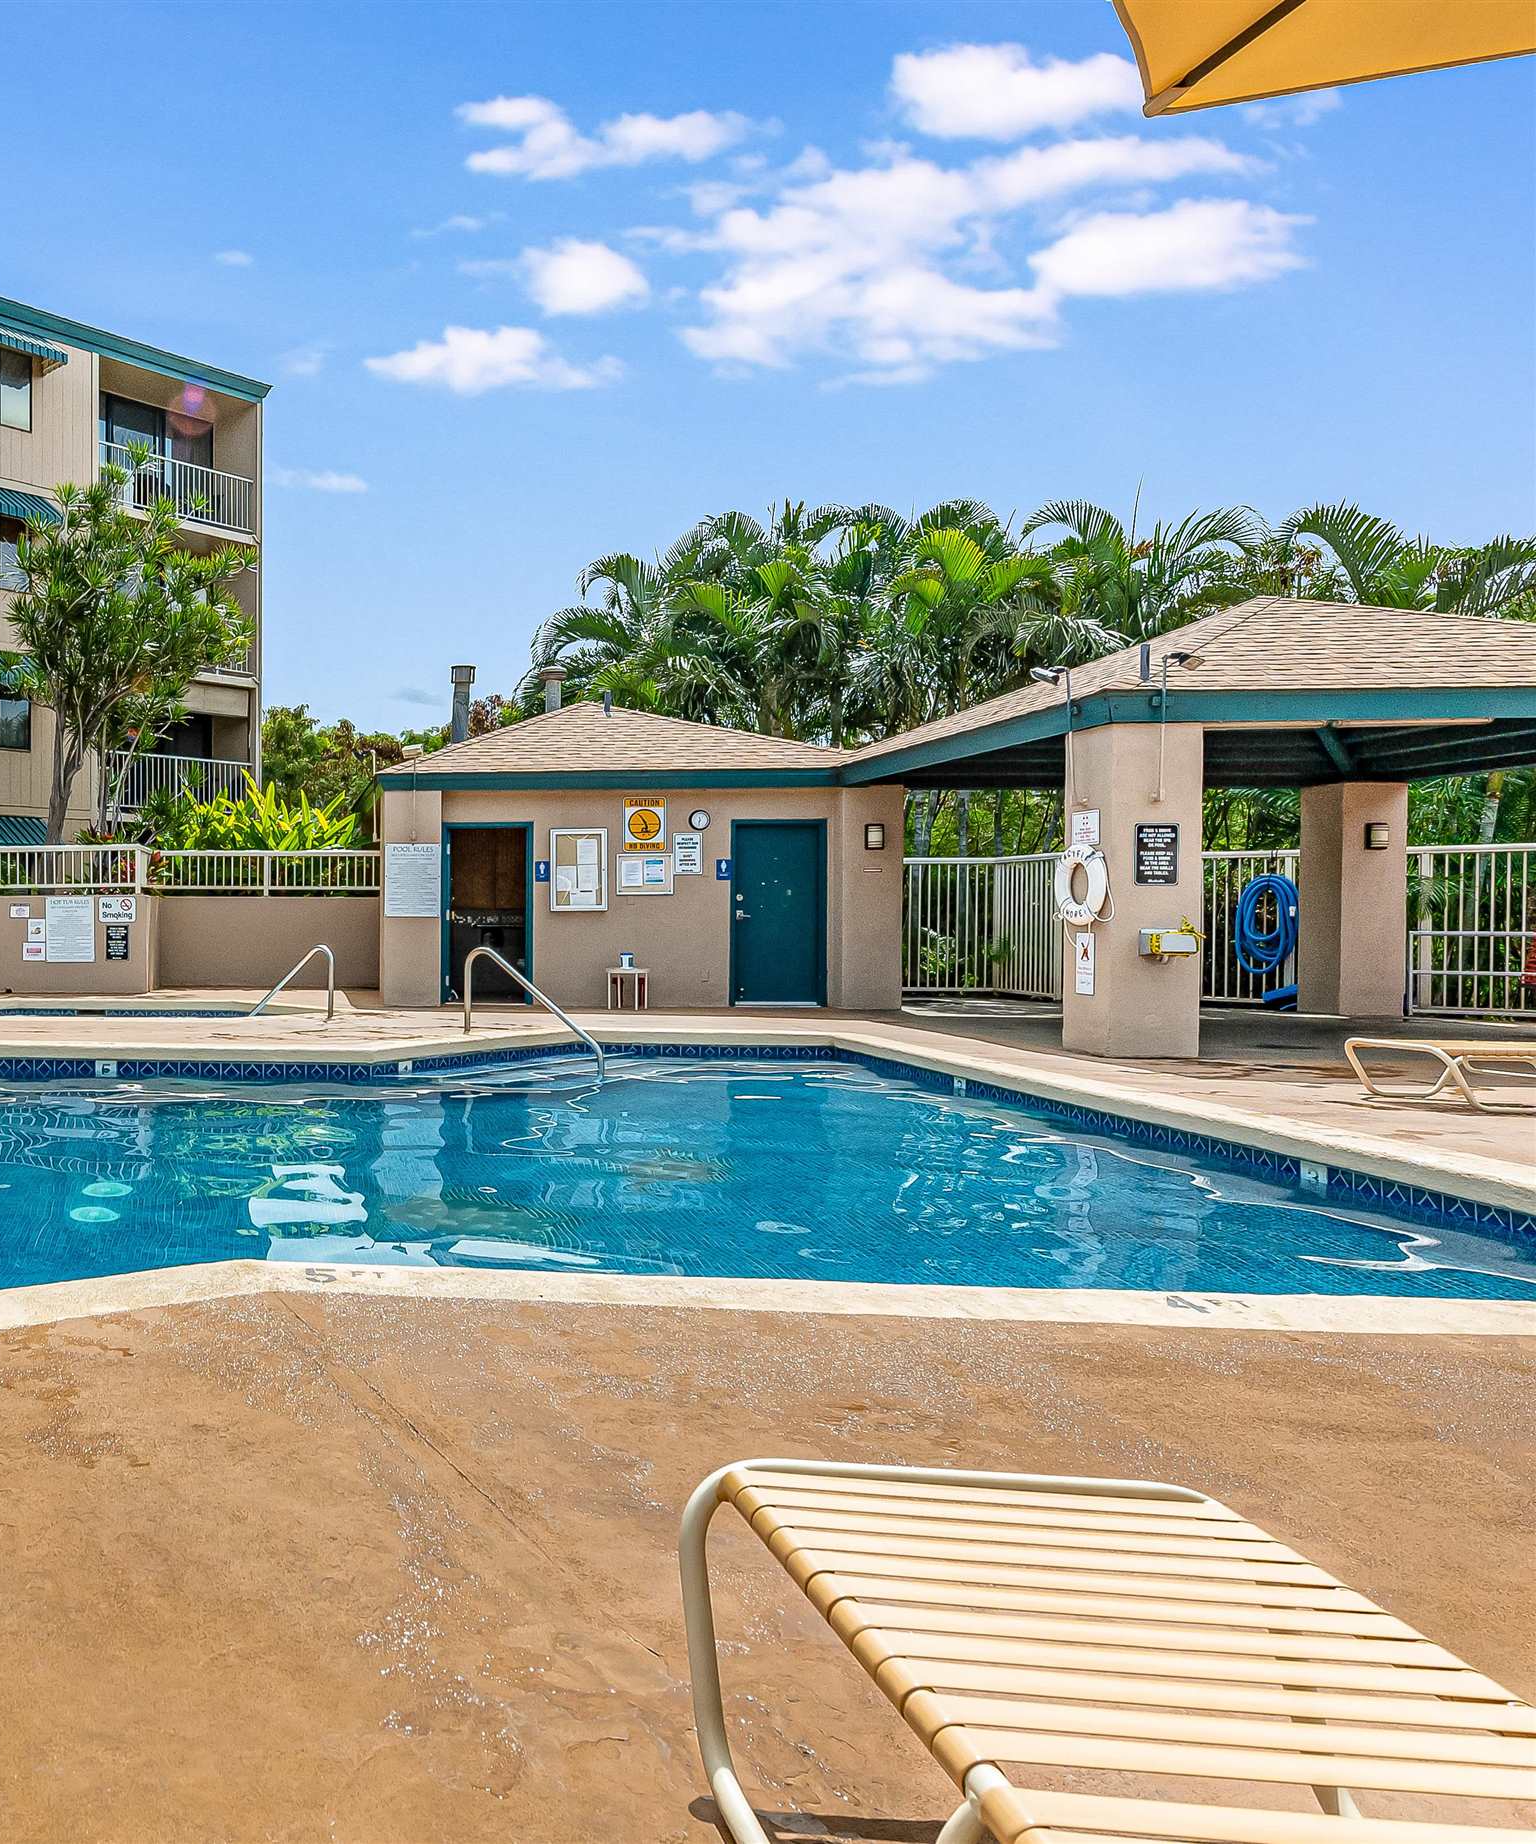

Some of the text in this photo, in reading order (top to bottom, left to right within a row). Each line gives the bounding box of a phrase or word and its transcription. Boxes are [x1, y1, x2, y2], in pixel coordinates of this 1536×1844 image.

[629, 799, 660, 807] CAUTION
[629, 842, 660, 850] NO DIVING
[101, 911, 133, 920] Smoking
[305, 1267, 385, 1283] 5 FT
[1166, 1296, 1211, 1313] 4
